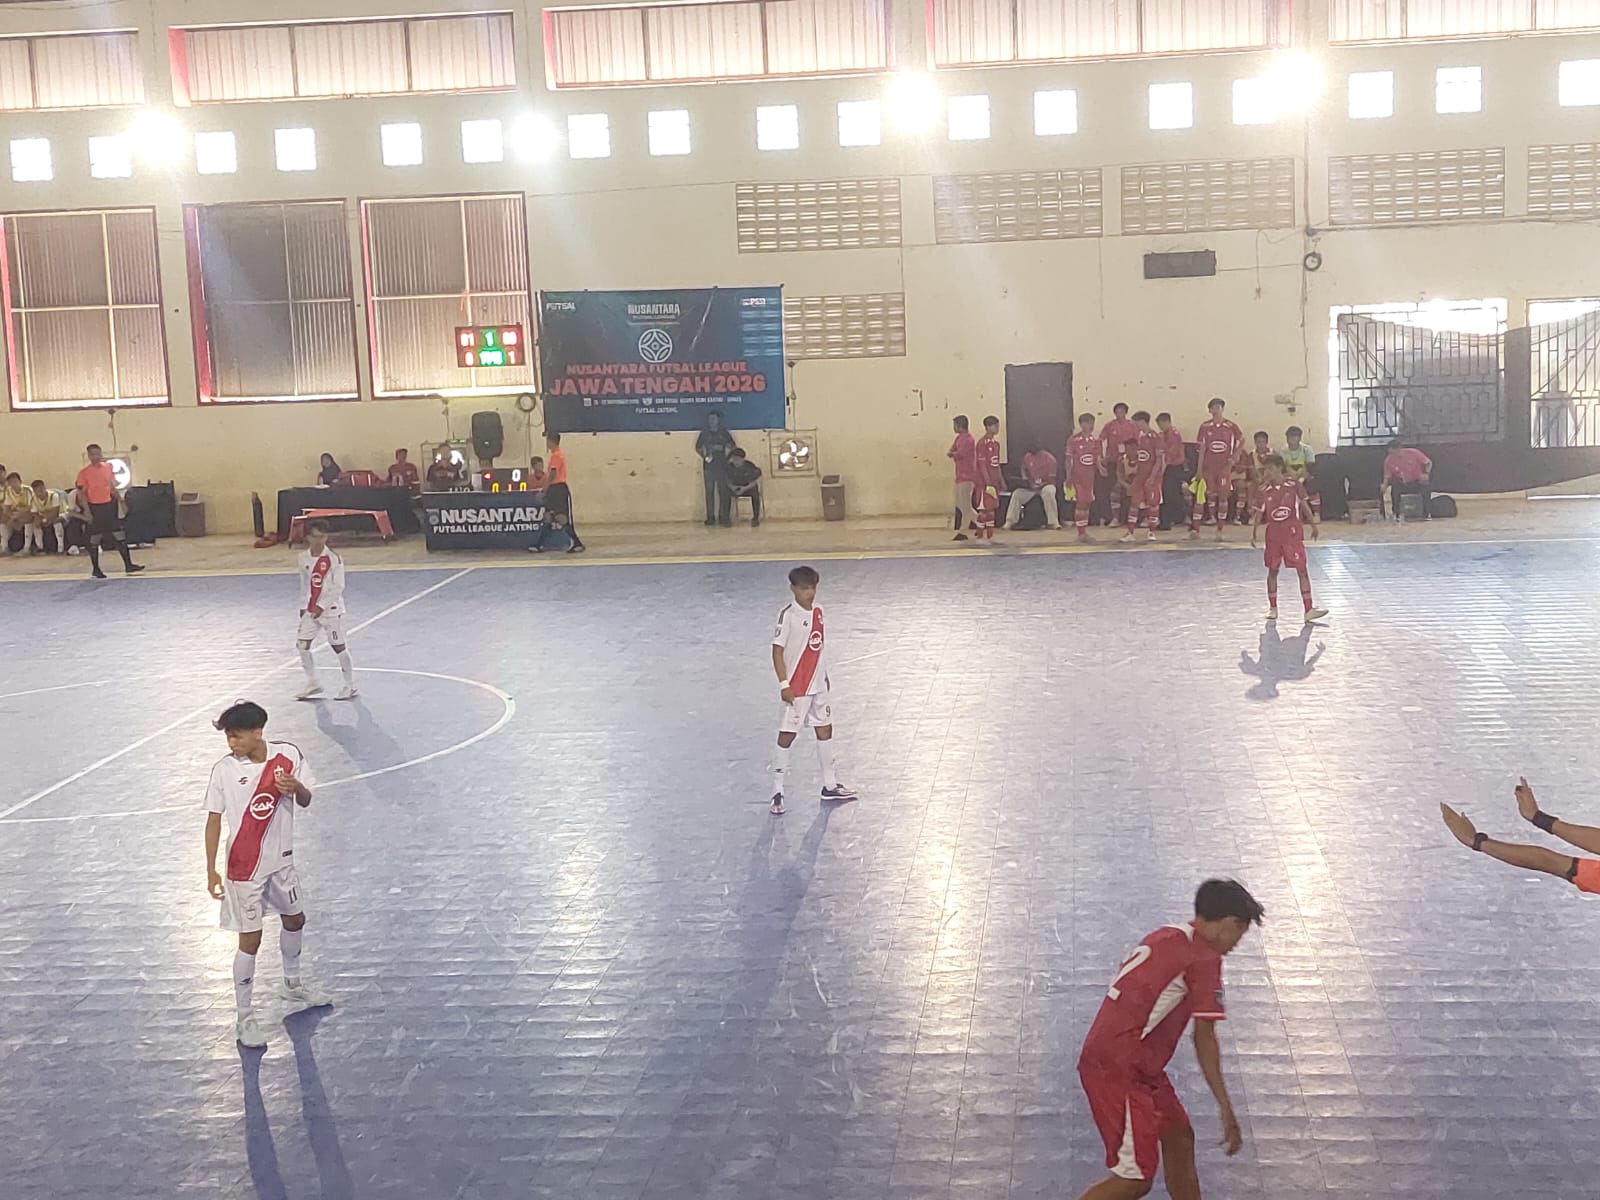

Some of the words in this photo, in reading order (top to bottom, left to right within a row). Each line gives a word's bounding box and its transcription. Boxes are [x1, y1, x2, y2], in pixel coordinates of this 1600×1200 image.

[627, 303, 681, 316] NUSANTARA
[484, 331, 494, 347] 1
[566, 363, 647, 376] NUSANTARA
[649, 362, 696, 375] FUTSAL
[699, 361, 748, 373] LEAGUE
[549, 377, 617, 396] JAWA
[621, 375, 711, 394] TENGAH
[714, 374, 766, 393] 2026
[511, 468, 521, 482] 0
[433, 525, 467, 534] FUTSAL
[468, 524, 503, 533] LEAGUE
[504, 523, 539, 532] JATENG
[825, 705, 831, 717] 9
[288, 886, 298, 905] 11
[1107, 945, 1151, 1000] 2
